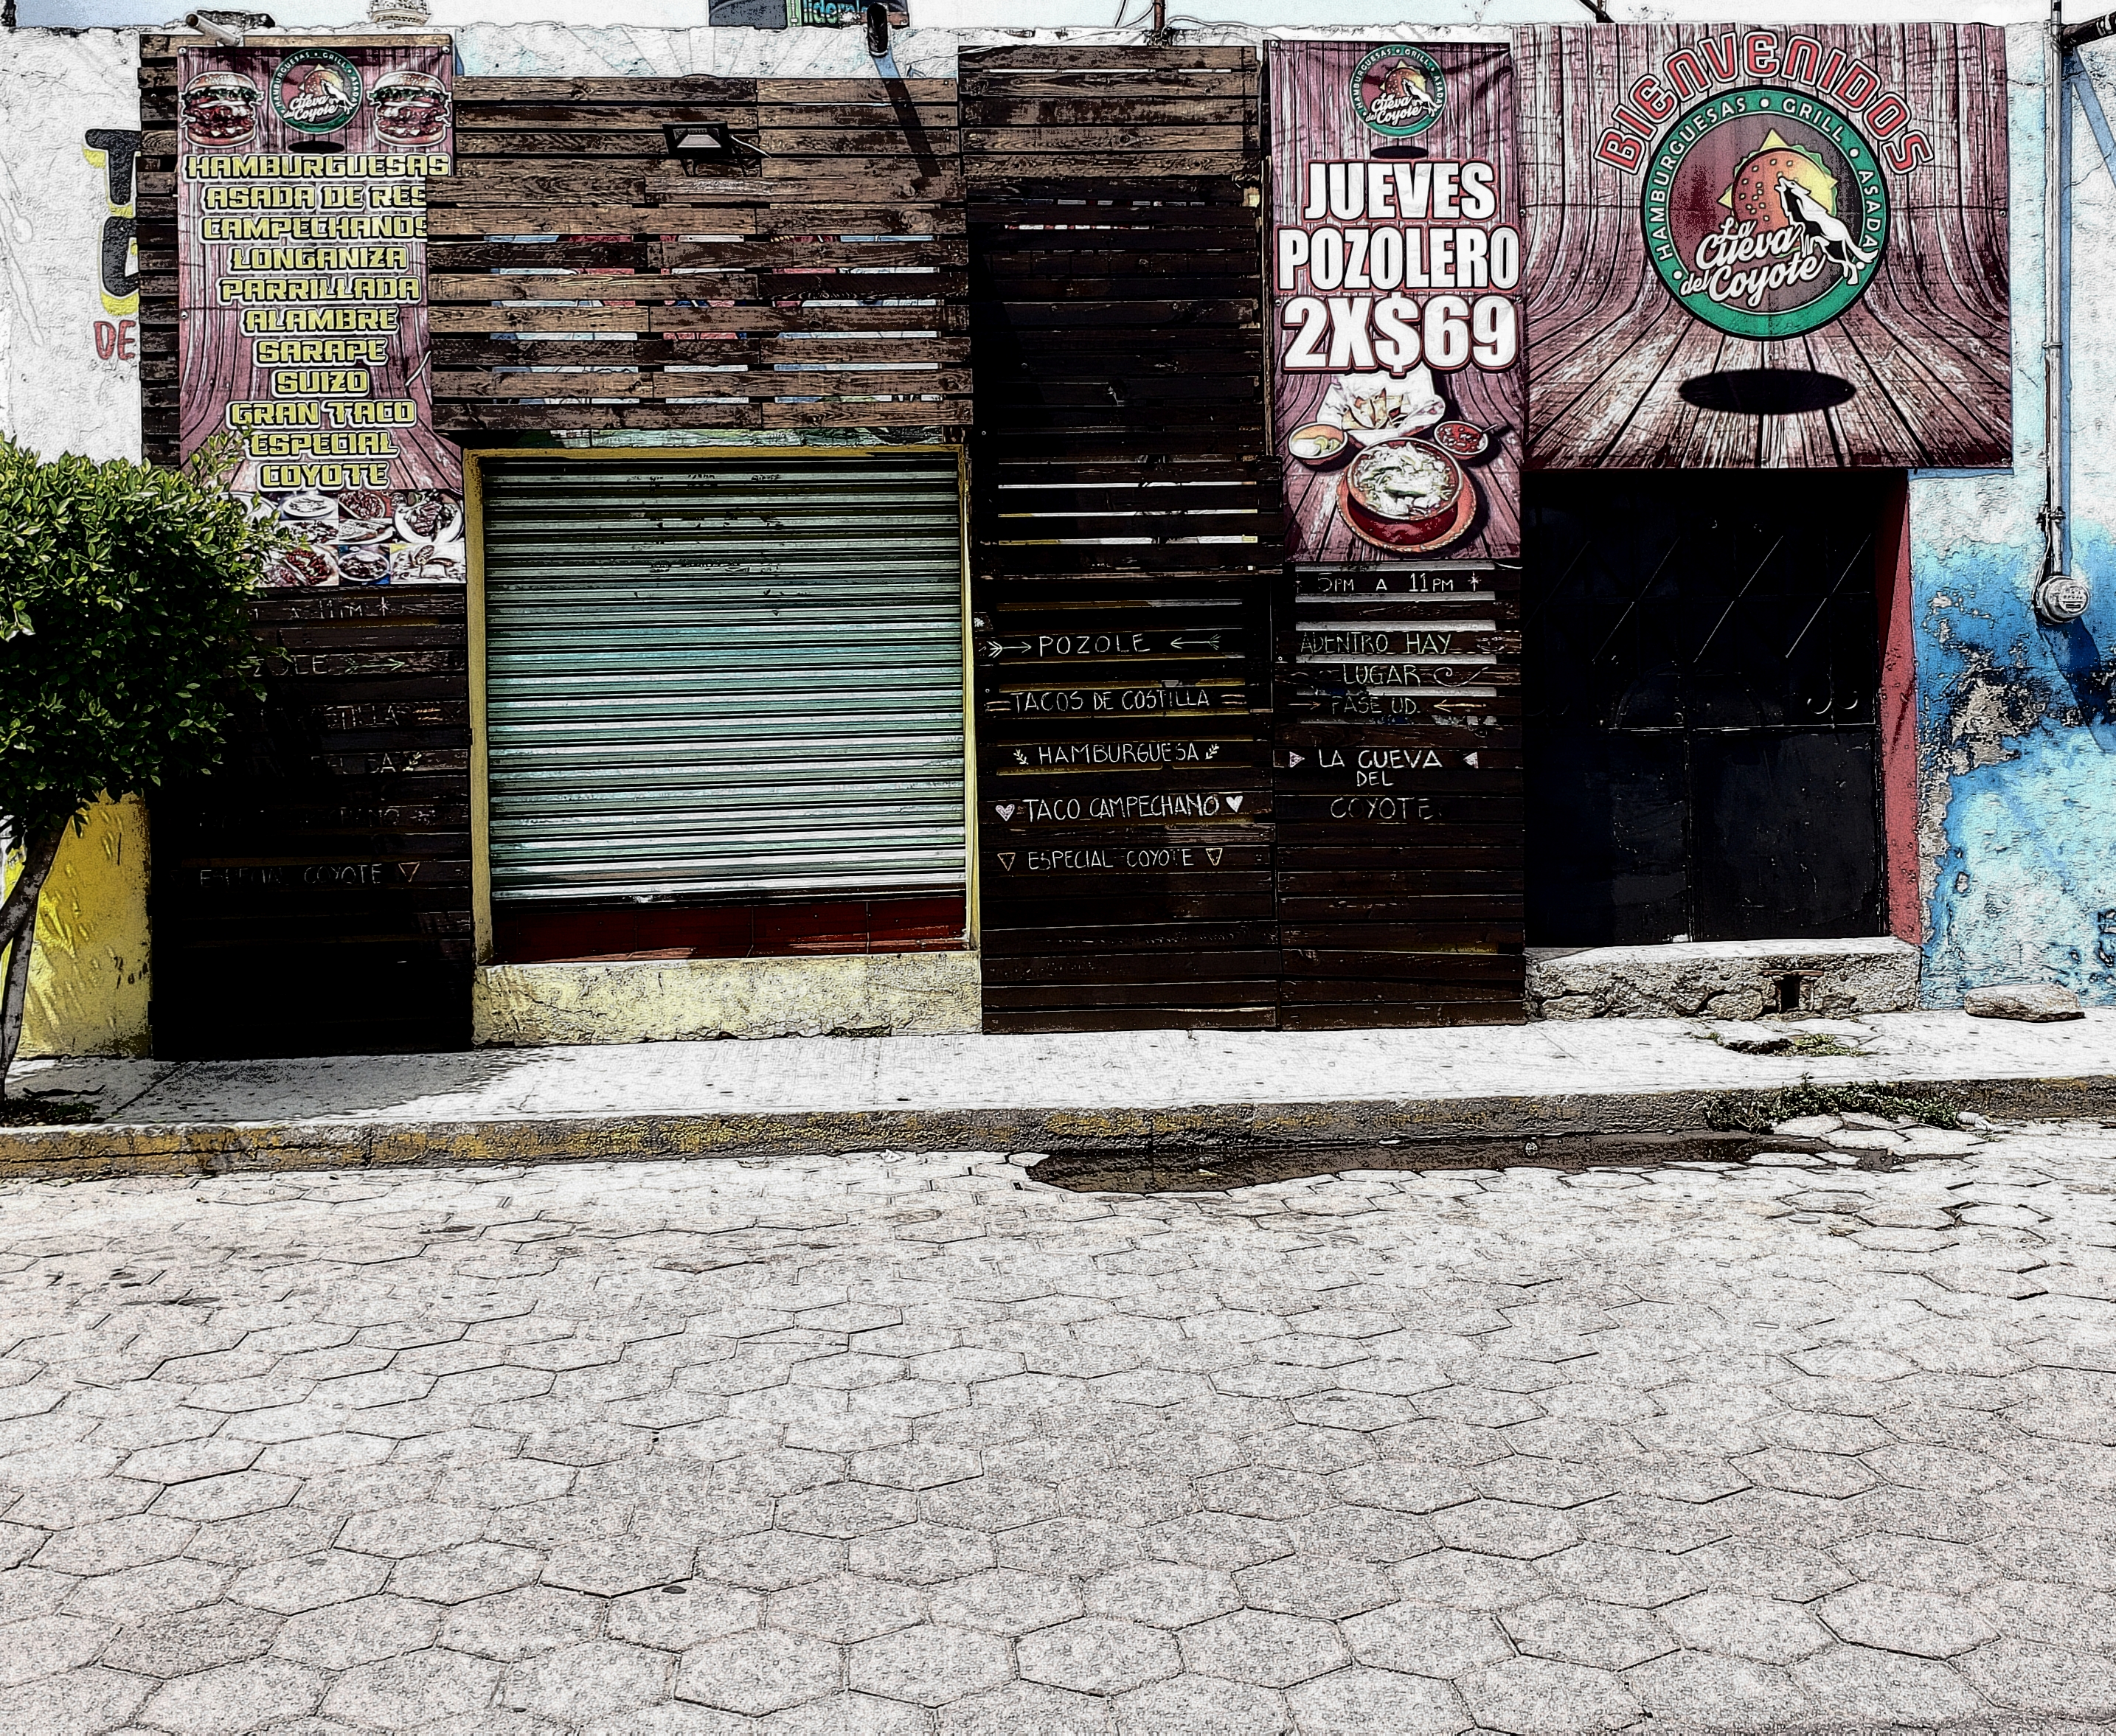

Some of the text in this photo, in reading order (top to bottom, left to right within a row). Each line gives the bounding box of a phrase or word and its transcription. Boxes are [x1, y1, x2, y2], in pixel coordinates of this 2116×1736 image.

[322, 52, 346, 68] GRILL
[1404, 48, 1429, 66] GRILL
[273, 52, 310, 107] HAMBURGUESAS
[350, 77, 359, 103] ASADA
[1353, 48, 1391, 109] HAMBURGUESAS
[1434, 75, 1444, 104] ASADA
[294, 104, 339, 122] Coyote
[1376, 105, 1423, 126] Coyote
[1594, 31, 1934, 175] BIENVENIDOS
[1782, 97, 1843, 143] GRILL
[186, 153, 451, 178] HAMBURGUESAS
[1648, 96, 1747, 261] HAMBURGUESAS
[204, 185, 316, 209] ASADA
[322, 185, 365, 208] DE
[1304, 162, 1497, 221] JUEVES
[1858, 169, 1881, 251] ASADA
[1717, 216, 1756, 243] La
[231, 247, 407, 271] LONGANIZA
[1277, 226, 1520, 291] POZOLERO
[1696, 223, 1804, 271] Cueva
[219, 277, 420, 302] PARRILLADA
[1681, 253, 1827, 307] del Coyote
[244, 308, 398, 333] ALAMBRE
[1283, 295, 1517, 375] 2X$69
[256, 339, 388, 363] SARAPE
[275, 370, 368, 394] SUIZO
[229, 400, 415, 426] GRAN TACO
[249, 432, 398, 456] ESPECIAL
[260, 462, 388, 487] COYOTE
[1317, 572, 1454, 592] 5PM A 11PM
[1039, 633, 1151, 656] POZOLE
[1300, 631, 1452, 654] ADENTRO HAY
[1343, 664, 1421, 687] LUGAR
[1010, 690, 1210, 713] TACOS DE COSTILLA
[1038, 743, 1199, 764] HAMBURGUESA
[1318, 749, 1345, 768] LA
[1356, 771, 1395, 787] DEL
[1022, 794, 1220, 822] TACO CAMPECHANO
[1331, 796, 1435, 820] COYOTE
[1027, 848, 1195, 870] ESPECIAL COYOTE
